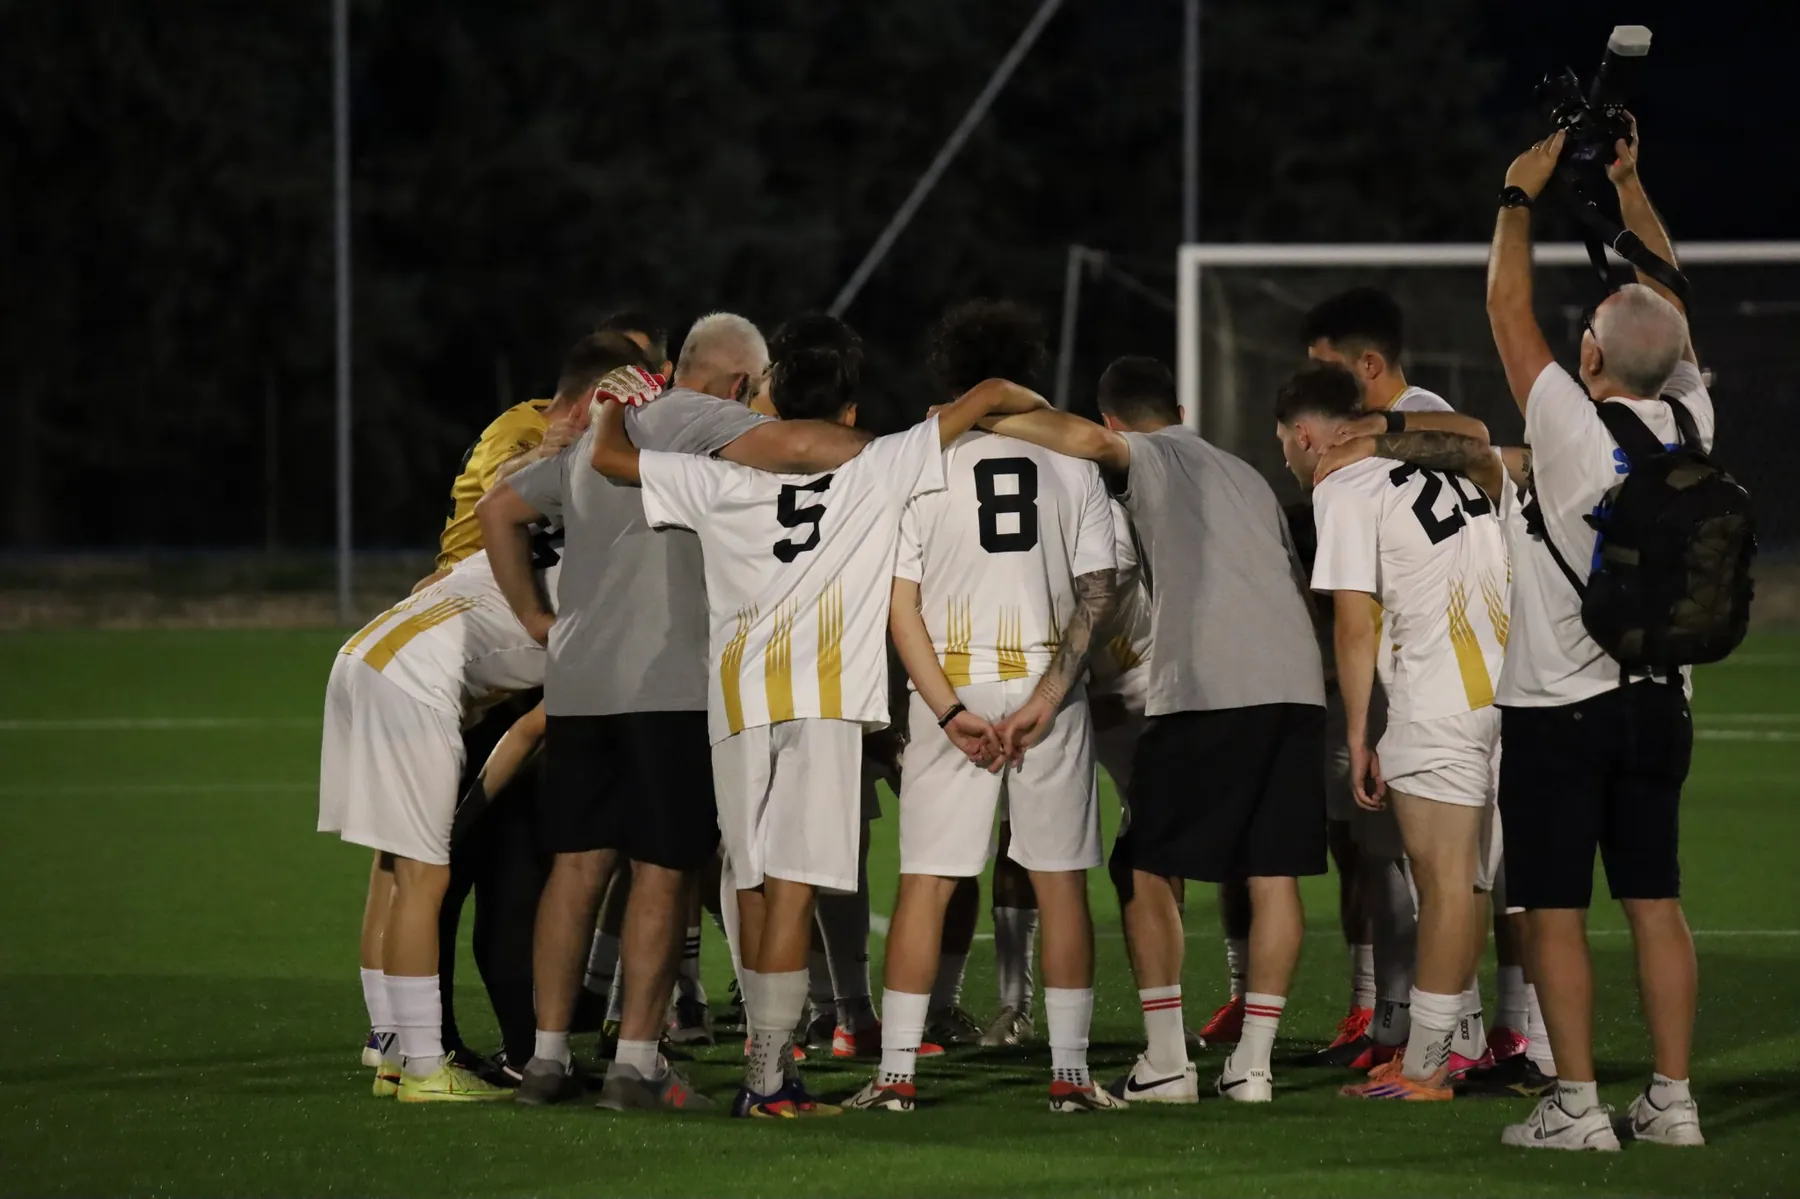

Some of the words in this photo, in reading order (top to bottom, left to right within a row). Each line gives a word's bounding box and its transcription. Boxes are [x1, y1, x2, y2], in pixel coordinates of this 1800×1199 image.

[773, 473, 835, 563] 5
[973, 456, 1039, 554] 8
[1460, 1018, 1470, 1040] SOCKS
